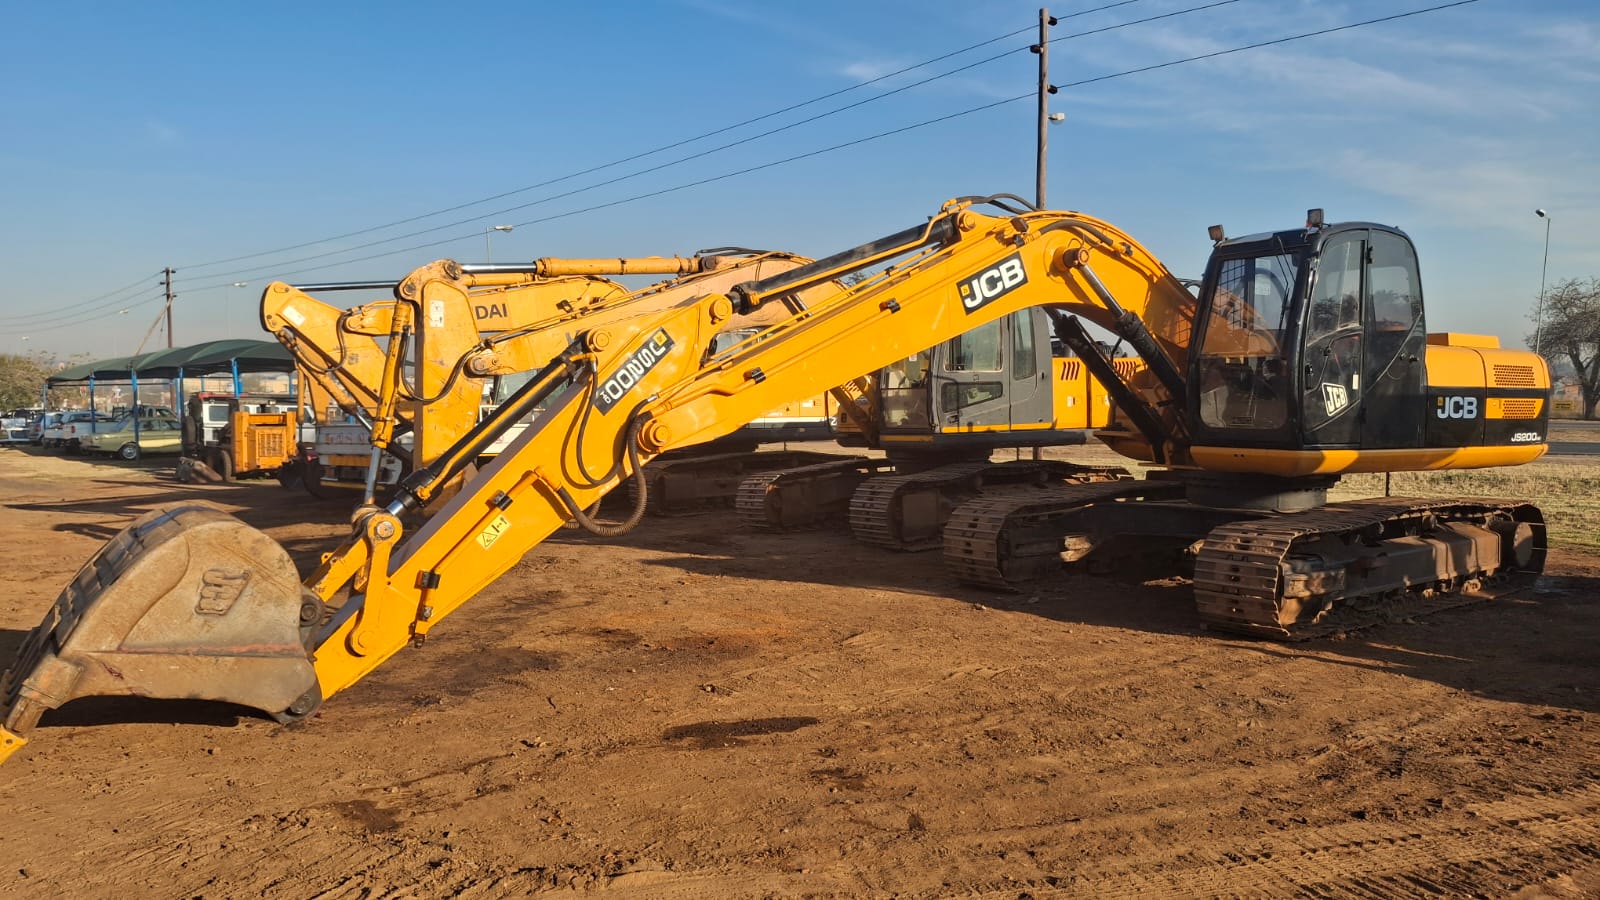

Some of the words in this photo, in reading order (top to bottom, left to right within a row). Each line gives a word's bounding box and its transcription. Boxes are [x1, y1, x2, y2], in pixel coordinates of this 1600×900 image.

[964, 258, 1025, 308] JCB
[475, 303, 508, 320] DAI
[1326, 386, 1347, 412] JCB
[1437, 397, 1478, 419] JCB
